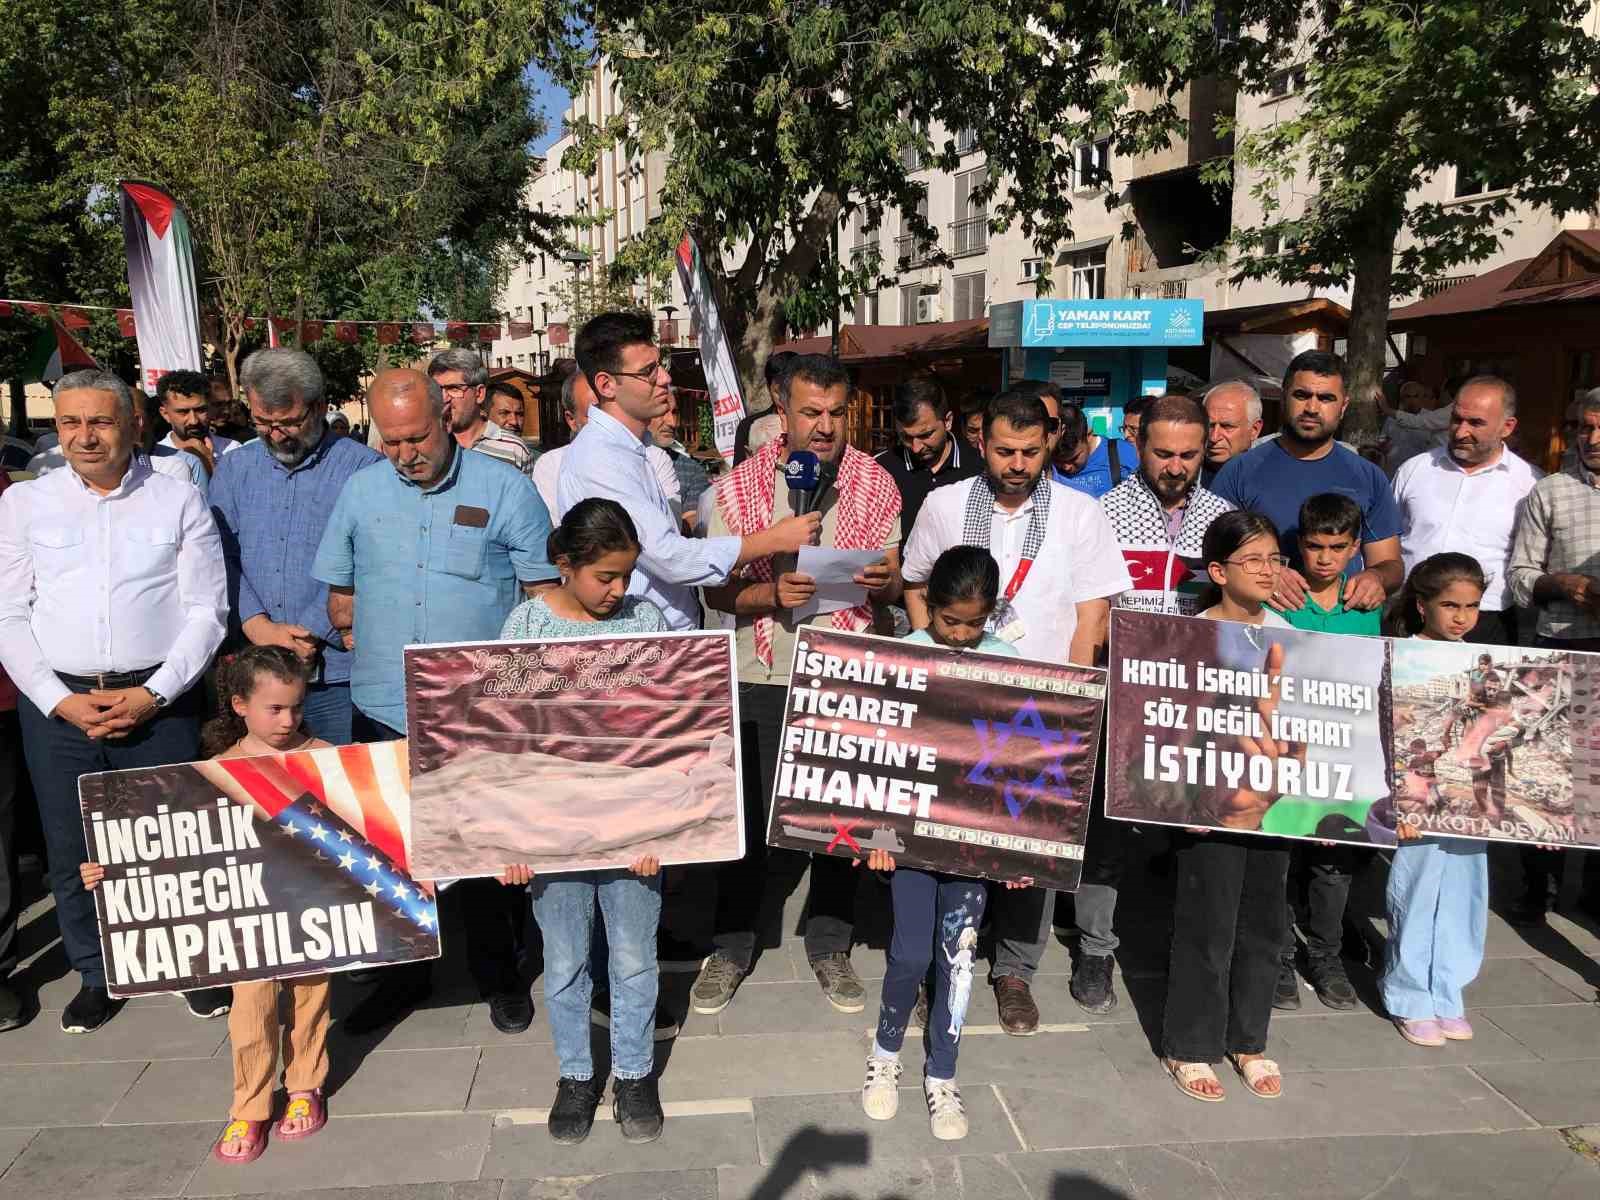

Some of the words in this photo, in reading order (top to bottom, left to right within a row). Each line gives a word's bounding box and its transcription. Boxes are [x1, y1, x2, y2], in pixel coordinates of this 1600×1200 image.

[1058, 310, 1110, 321] YAMAN
[1112, 310, 1152, 321] KART
[796, 641, 929, 692] İSRAİL'LE
[1122, 658, 1189, 689] KATİL
[1197, 661, 1295, 699] İSRAİL'E
[1302, 679, 1372, 716] KARŞI
[791, 679, 917, 729] TİCARET
[1143, 698, 1188, 730] SÖZ
[1196, 704, 1263, 738] DEĞİL
[1271, 710, 1352, 748] İCRAAT
[783, 718, 937, 773] FİLİSTİN'E
[1143, 735, 1353, 801] İSTİYORUZ
[777, 752, 938, 818] İHANET
[92, 797, 261, 865] İNCİRLİK
[102, 856, 269, 925] KÜRECİK
[110, 901, 378, 985] KAPATILSIN
